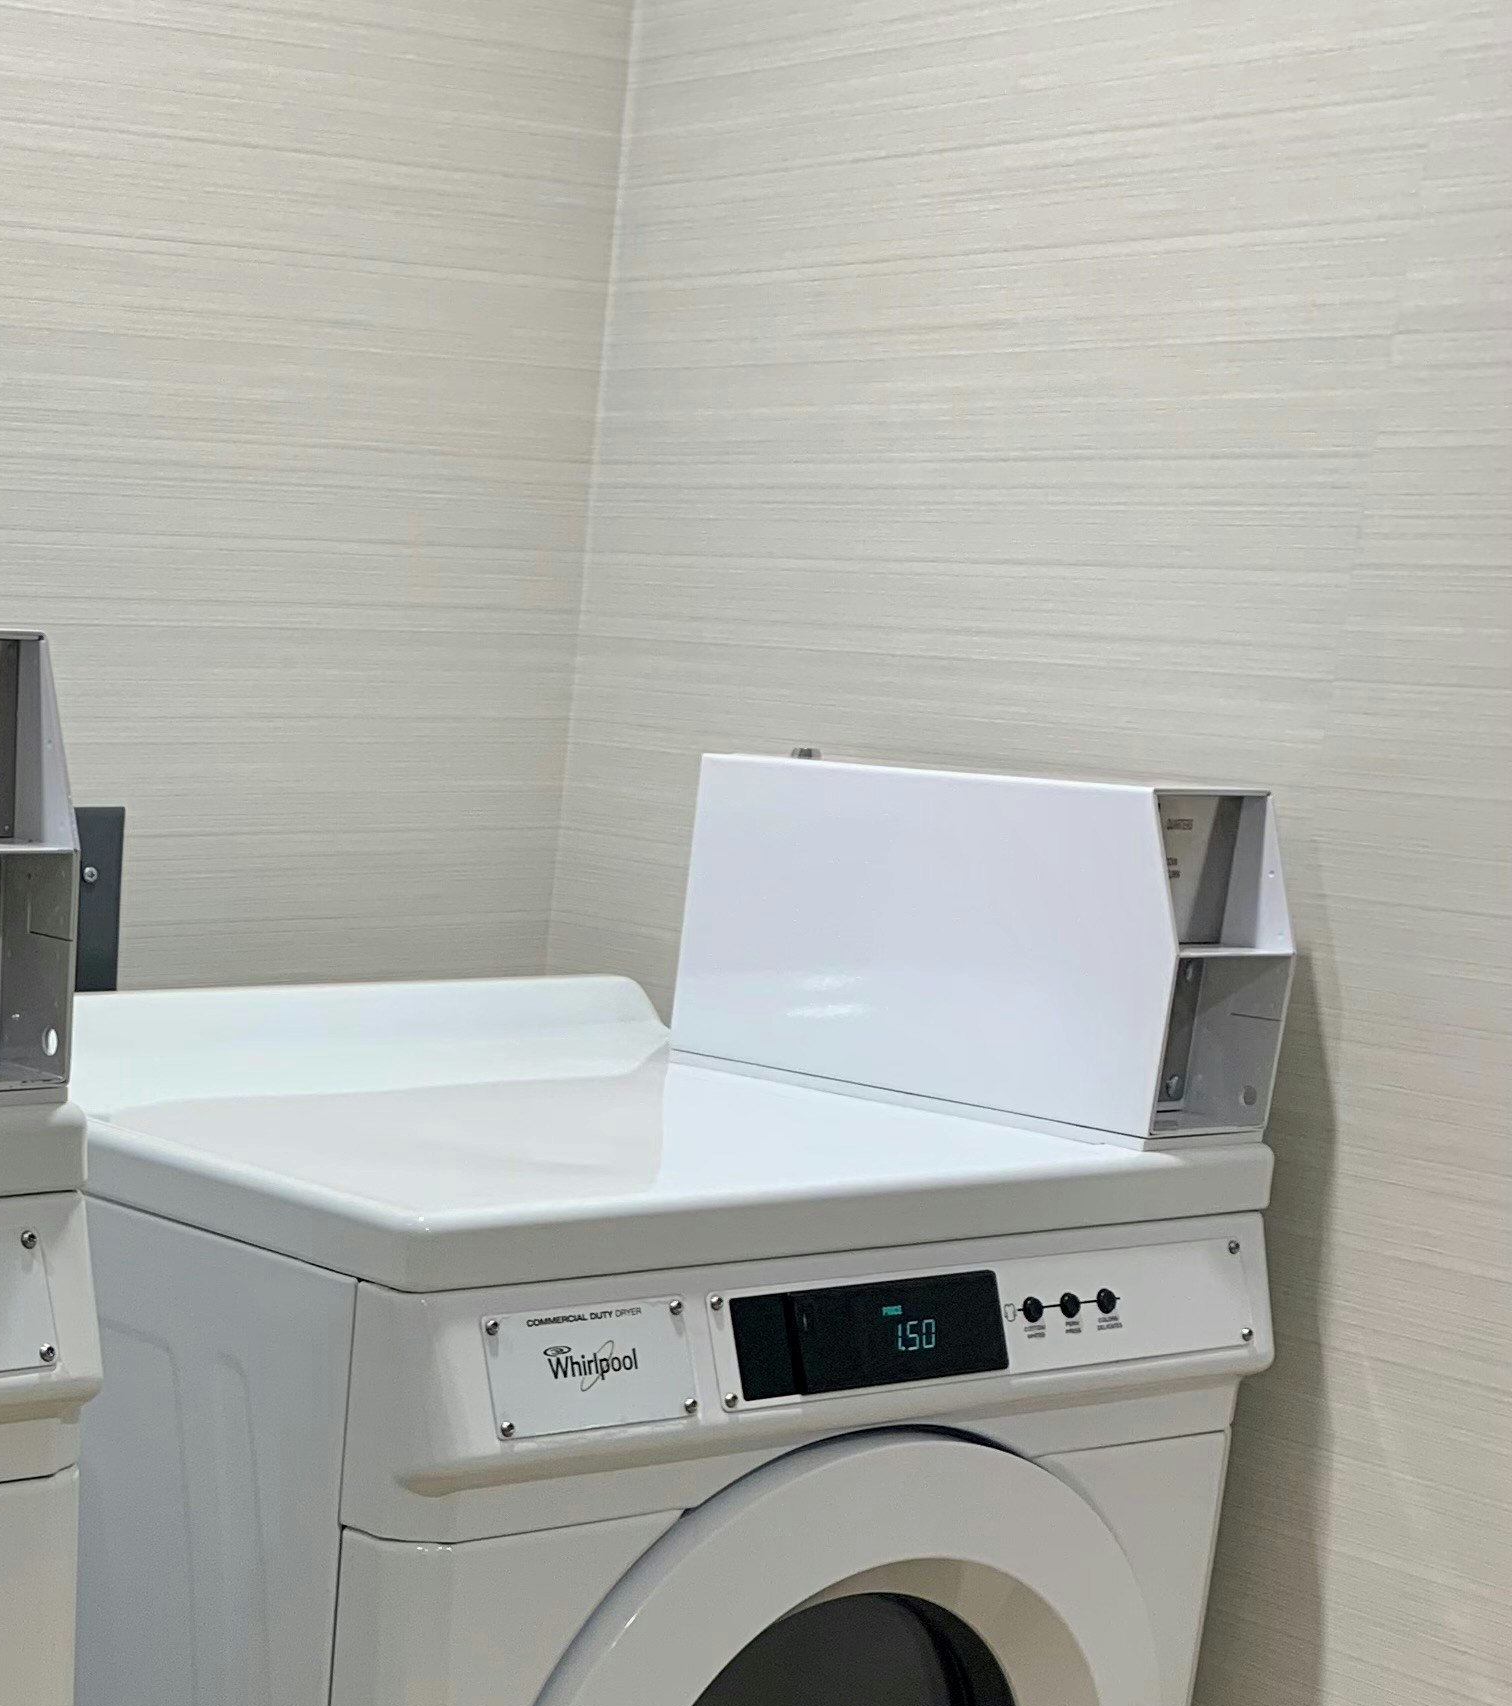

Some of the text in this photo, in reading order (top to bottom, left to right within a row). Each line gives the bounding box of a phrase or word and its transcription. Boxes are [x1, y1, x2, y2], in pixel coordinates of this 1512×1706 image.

[526, 1307, 642, 1327] COMMERCIAL DUTY DRYER
[898, 1319, 936, 1350] 1.50
[547, 1348, 638, 1380] Whirlpool
